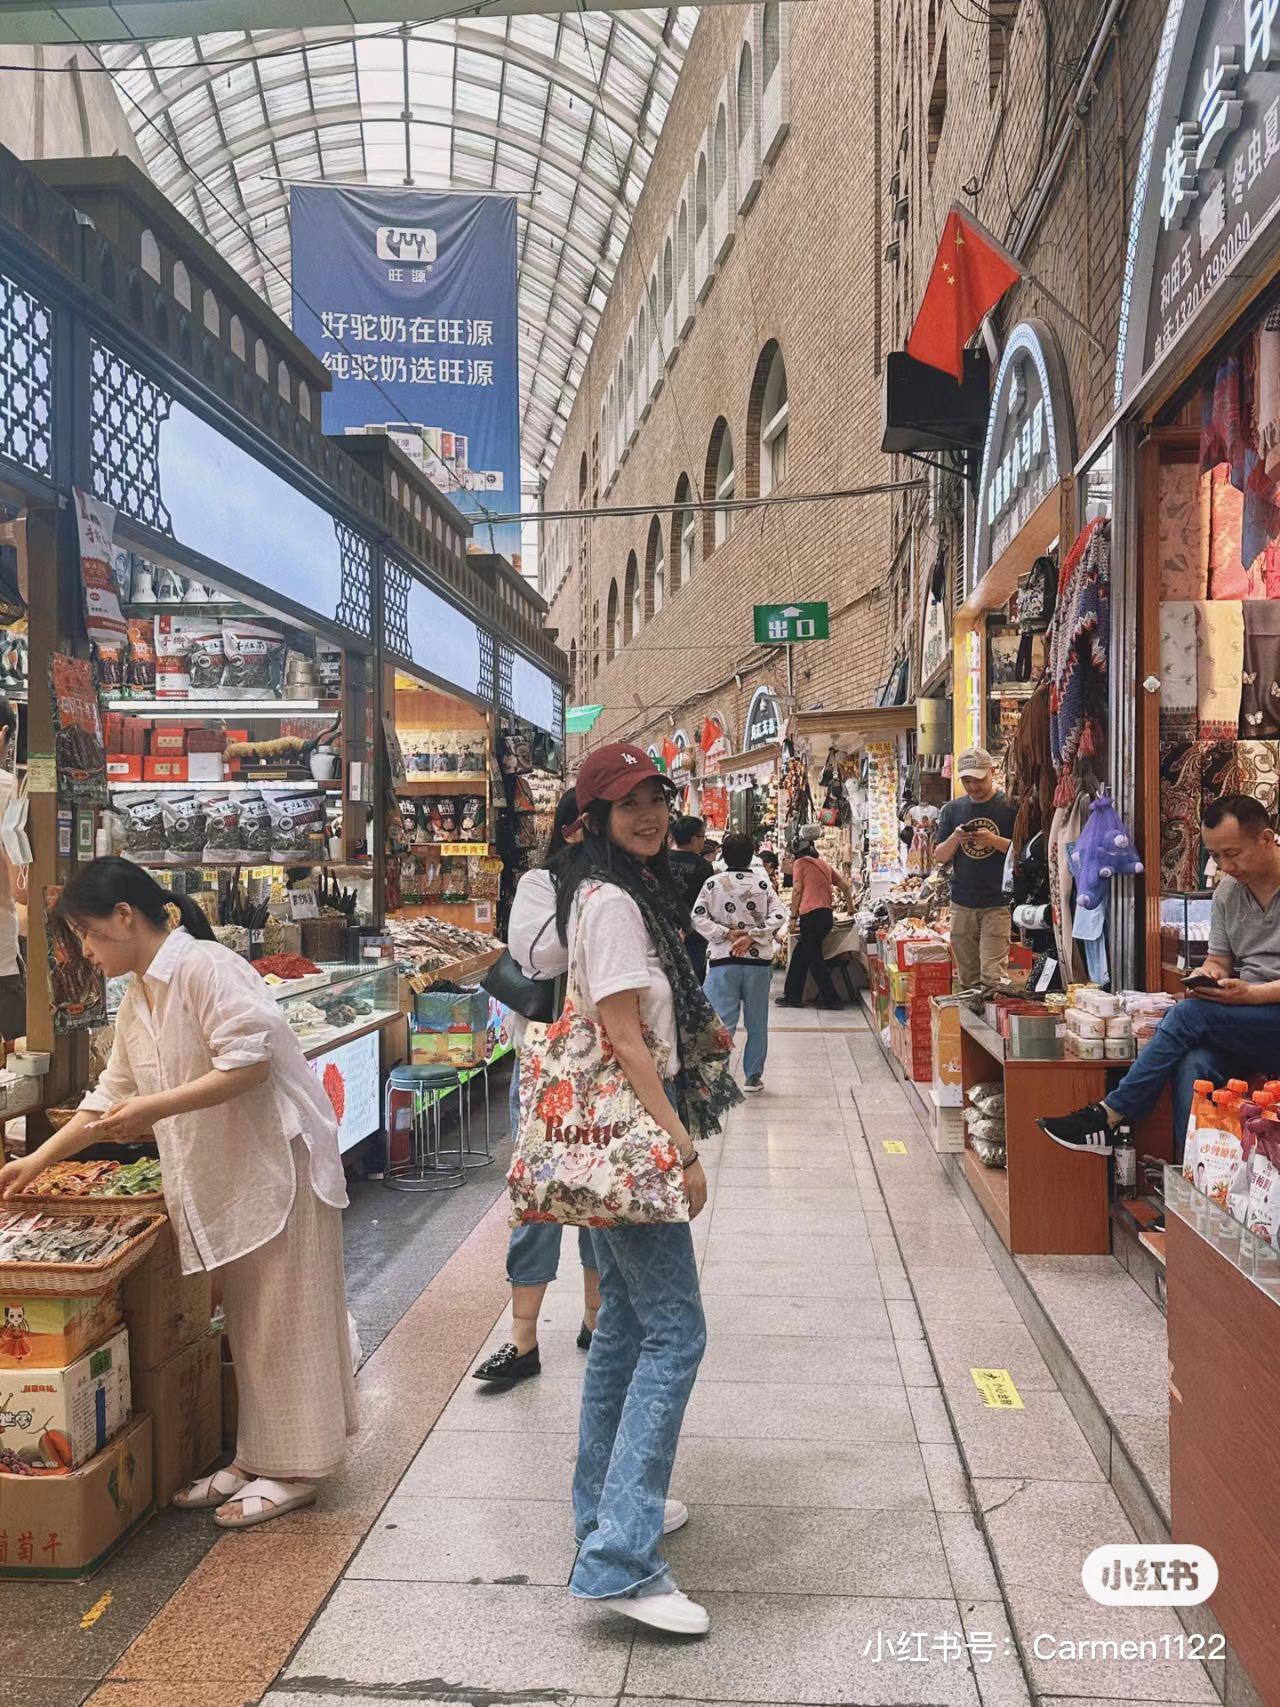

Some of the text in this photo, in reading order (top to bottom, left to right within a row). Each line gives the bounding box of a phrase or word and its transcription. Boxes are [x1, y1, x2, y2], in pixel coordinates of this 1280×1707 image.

[388, 268, 427, 283] 旺源
[1160, 235, 1193, 317] 和田玉
[320, 311, 494, 347] 好驼奶在旺源
[321, 351, 495, 387] 纯驼奶选旺源
[768, 619, 815, 639] 出口
